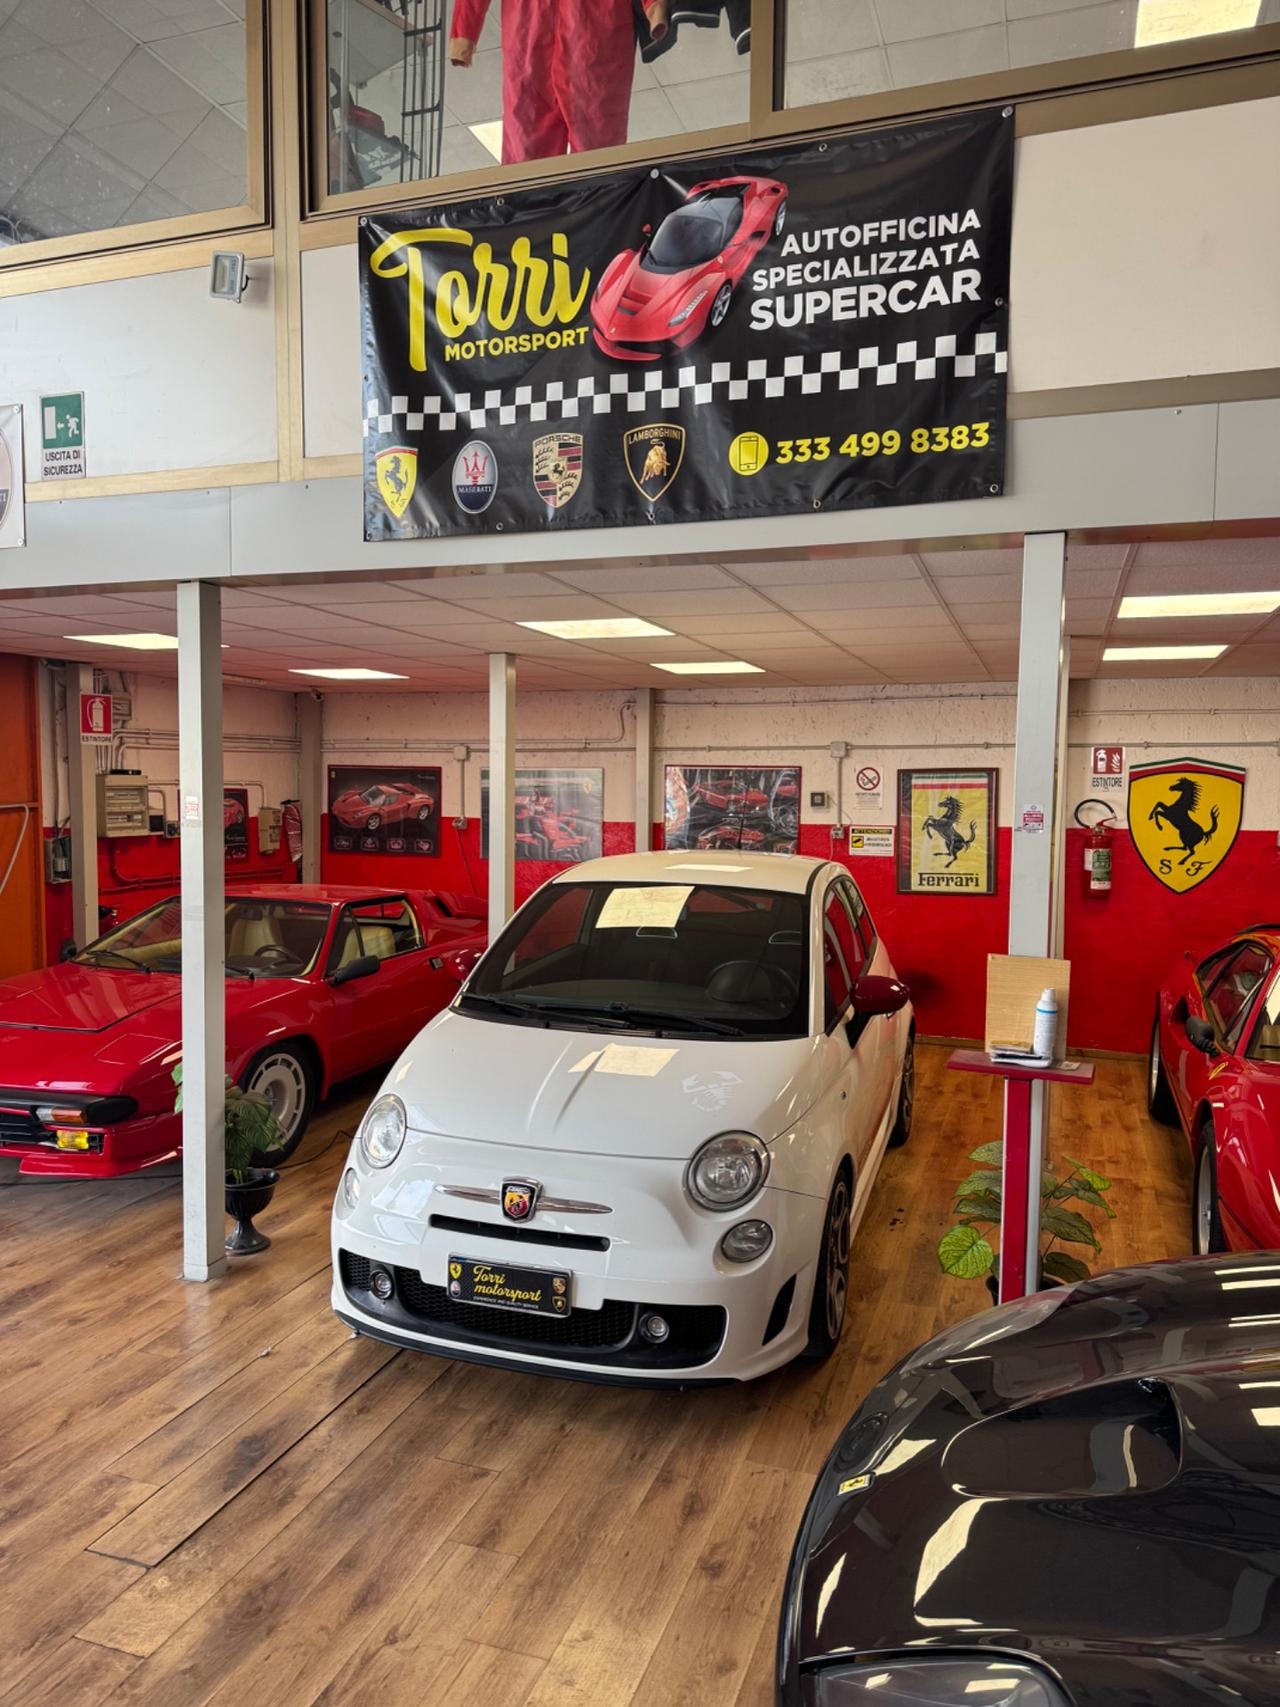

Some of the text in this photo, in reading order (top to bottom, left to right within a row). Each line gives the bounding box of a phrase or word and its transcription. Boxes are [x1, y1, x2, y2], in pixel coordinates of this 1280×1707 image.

[780, 208, 981, 257] AUTOFFICINA
[752, 238, 980, 292] SPECIALIZZATA
[370, 227, 590, 372] Torri
[749, 268, 982, 331] SUPERCAR
[444, 326, 590, 362] MOTORSPORT
[535, 435, 581, 449] PORSCHE
[628, 427, 681, 444] LAMBORGHINI
[775, 421, 990, 464] 333 499 8383
[45, 449, 80, 462] USCITA DI
[43, 464, 83, 476] SICUREZZA
[458, 486, 492, 494] MASERATI
[1092, 776, 1122, 788] ESTINTORE
[1159, 859, 1212, 876] S F
[917, 872, 979, 887] Ferrari
[473, 1265, 506, 1284] Torri
[473, 1284, 542, 1302] motorsport
